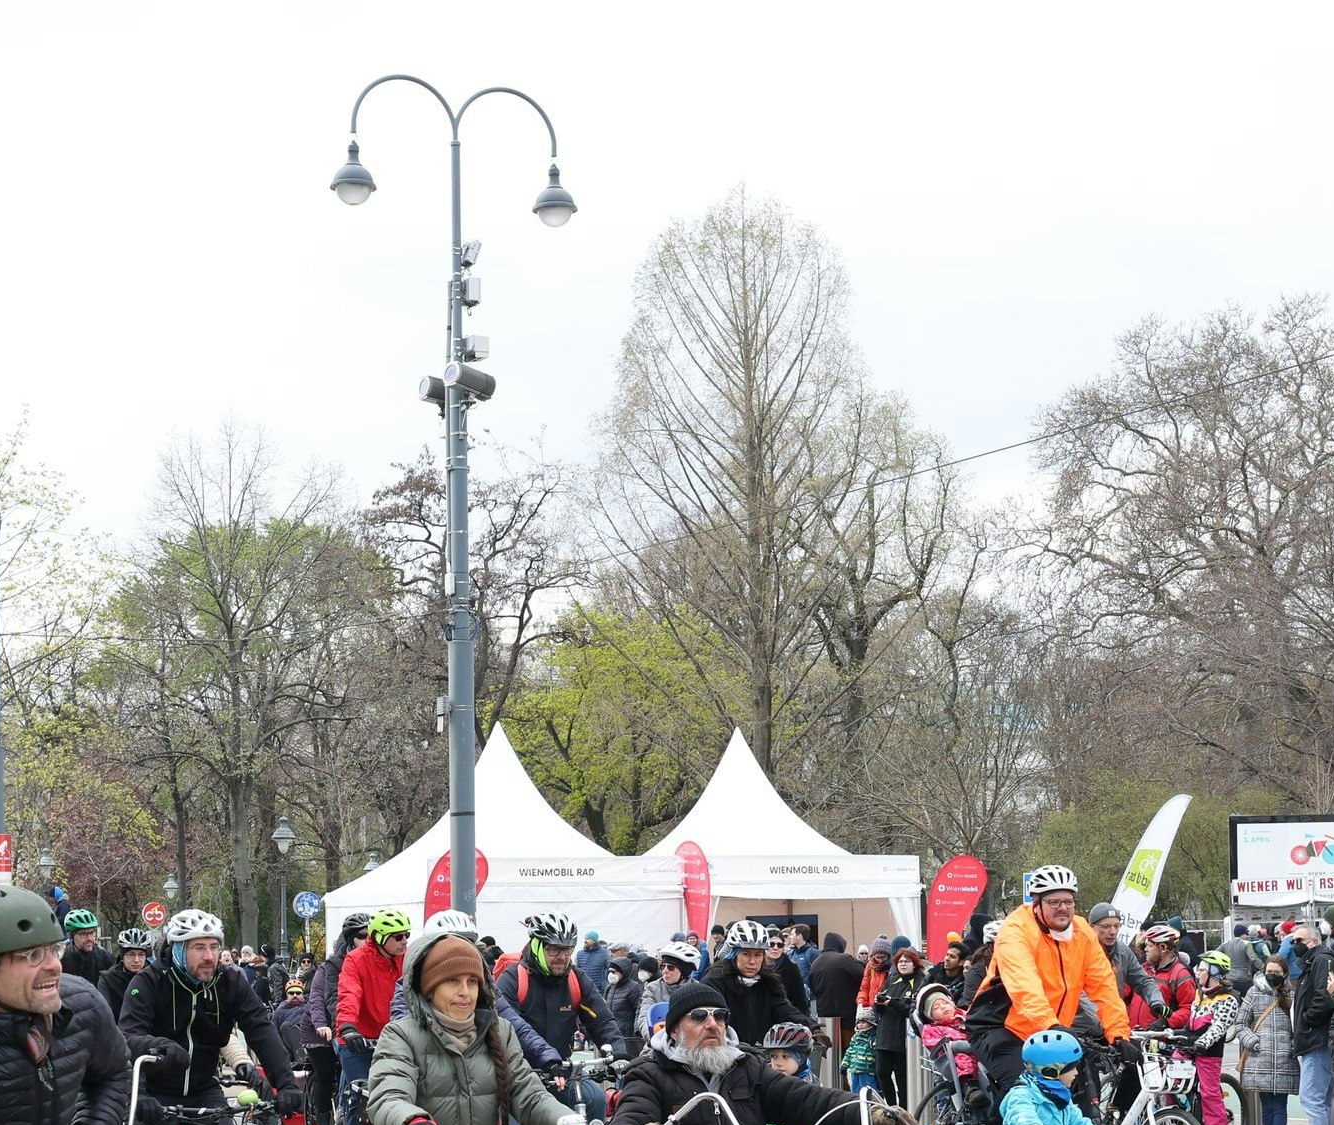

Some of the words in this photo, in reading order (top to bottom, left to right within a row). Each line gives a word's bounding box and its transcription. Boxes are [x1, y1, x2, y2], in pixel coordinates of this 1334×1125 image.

[519, 868, 575, 877] WIENMOBIL
[576, 868, 595, 877] RAD
[769, 865, 820, 875] WIENMOBIL
[822, 865, 840, 874] RAD
[1237, 880, 1278, 893] WIENER
